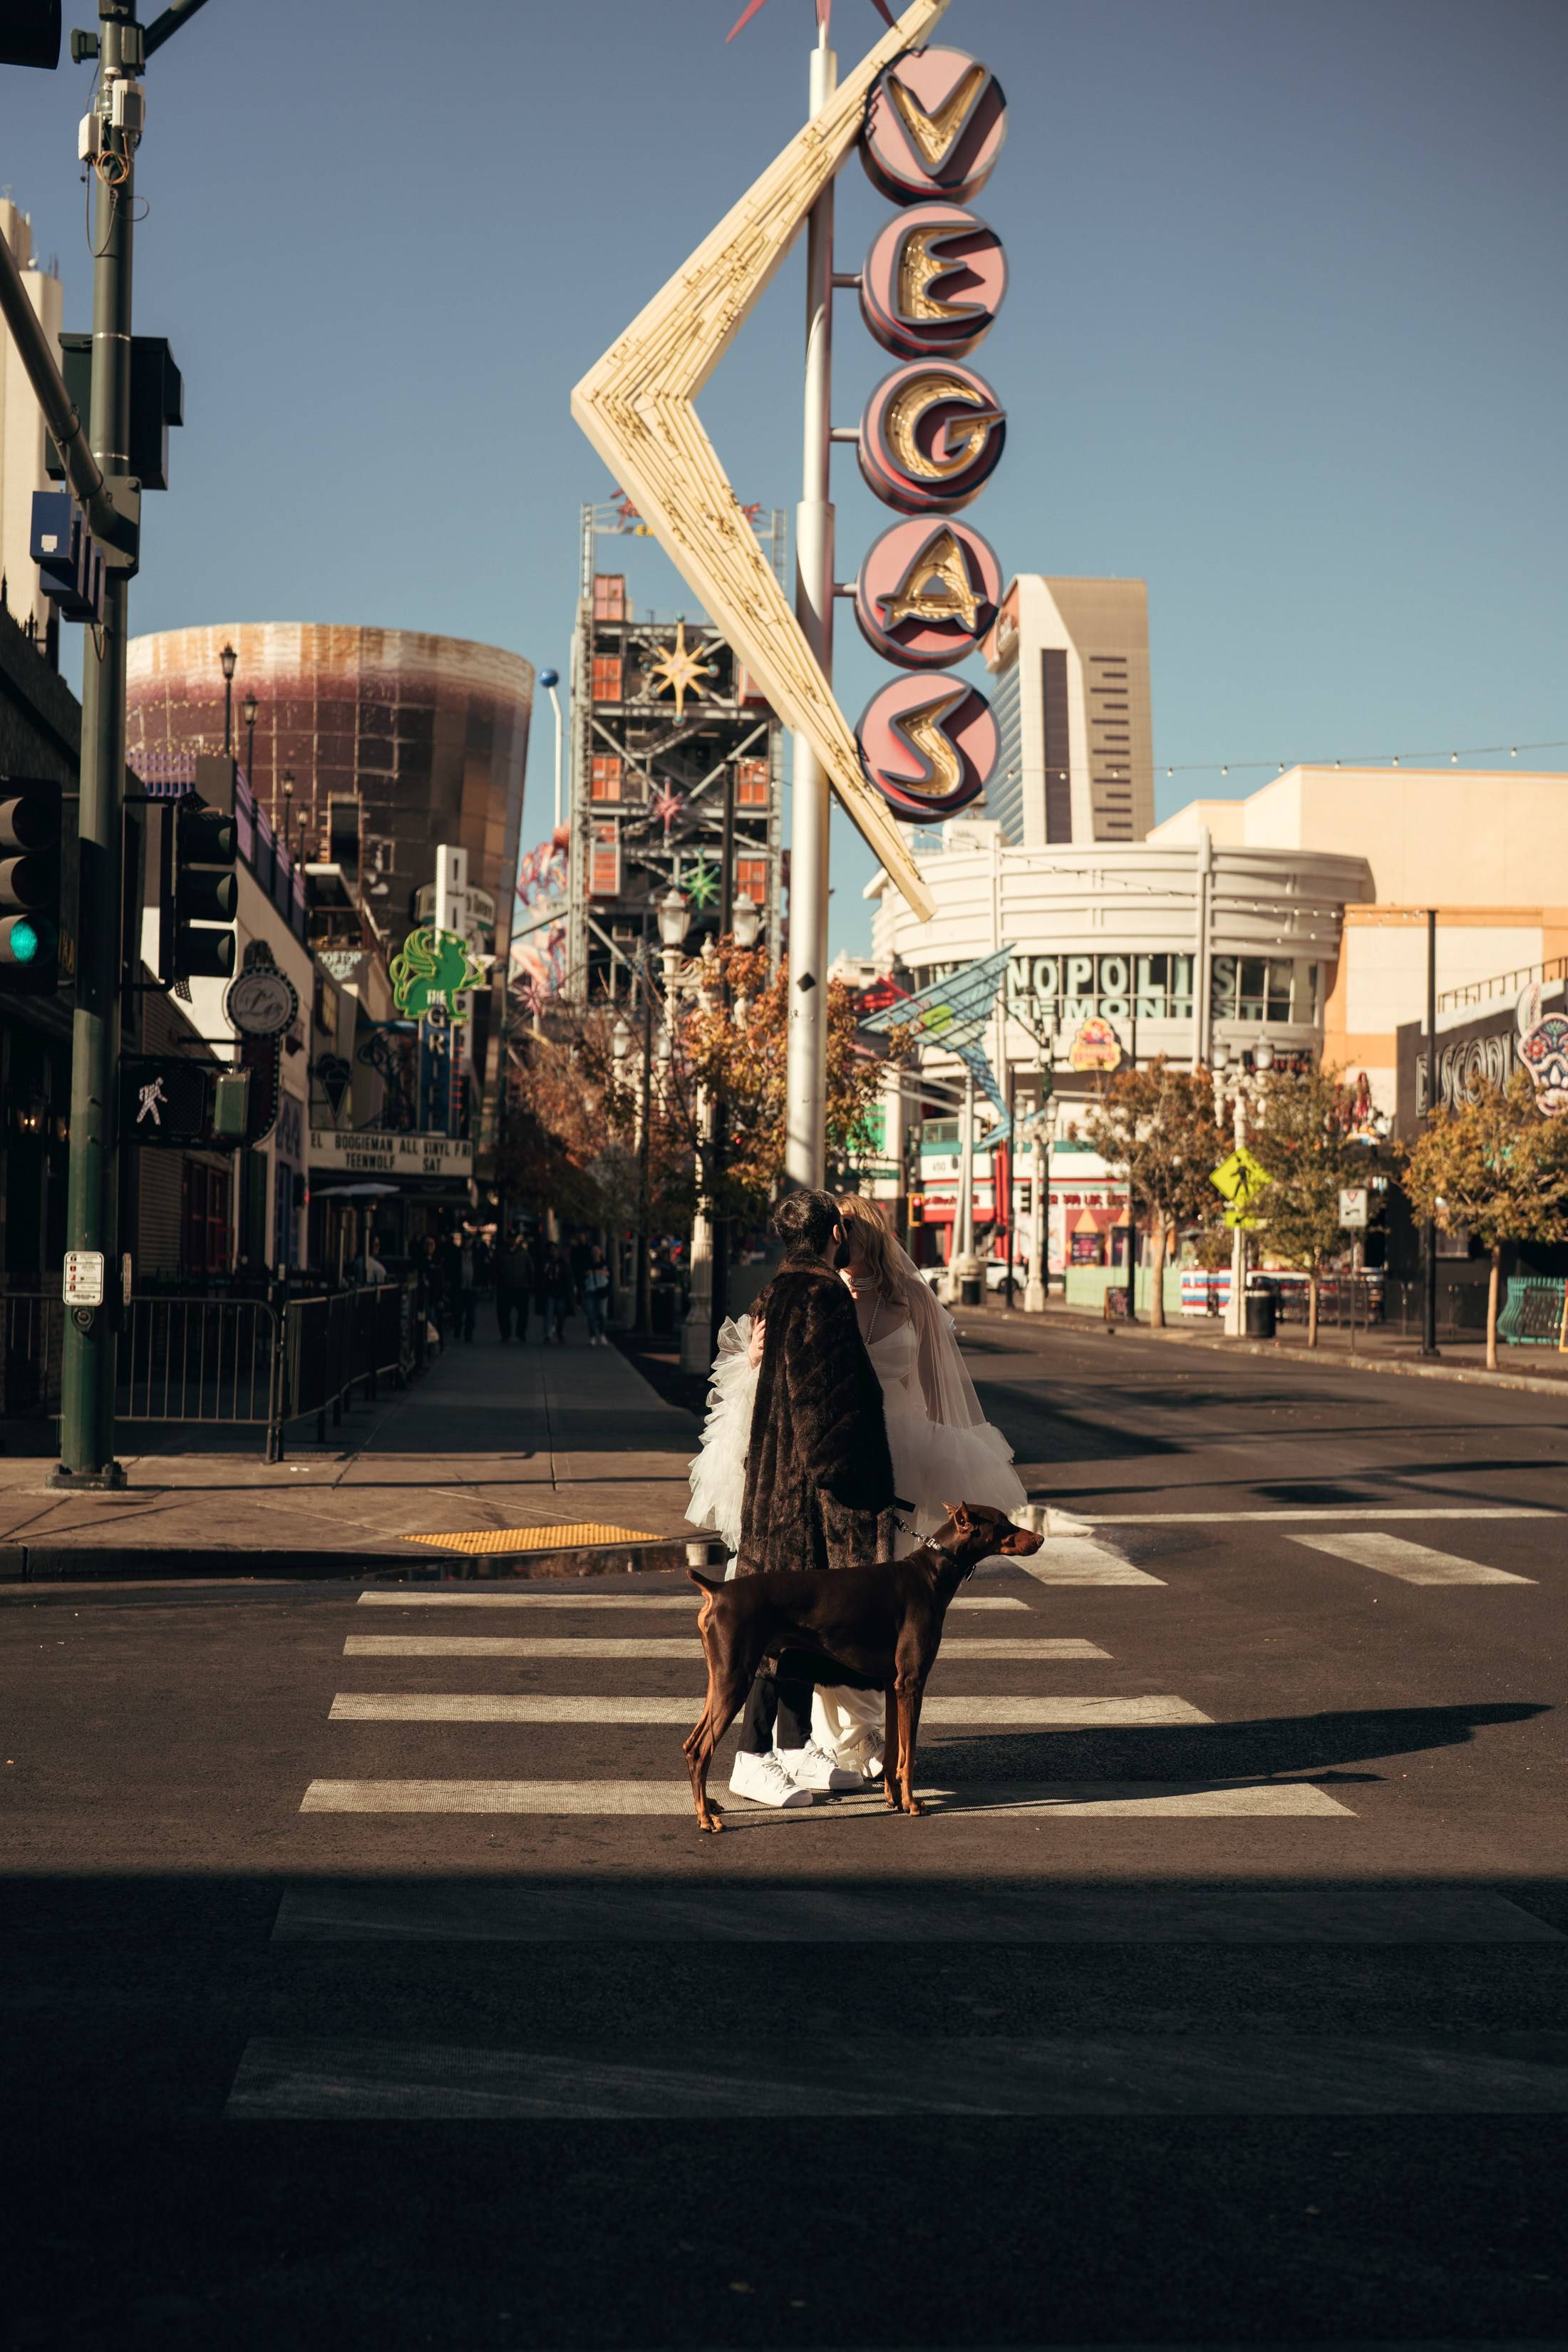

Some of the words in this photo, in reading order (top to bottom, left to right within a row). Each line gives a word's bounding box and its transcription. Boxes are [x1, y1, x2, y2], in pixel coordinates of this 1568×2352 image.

[878, 61, 1006, 798] VEGAS
[935, 956, 1235, 999] NOPOLIS
[1008, 999, 1194, 1019] REMONT
[427, 1006, 447, 1131] GRIFF
[311, 1131, 322, 1148] EL
[335, 1135, 393, 1152] BOOGIEMAN
[399, 1139, 418, 1155] ALL
[423, 1140, 450, 1156] VINYL
[346, 1152, 396, 1169] TEENWOLF
[423, 1157, 441, 1172] SAT
